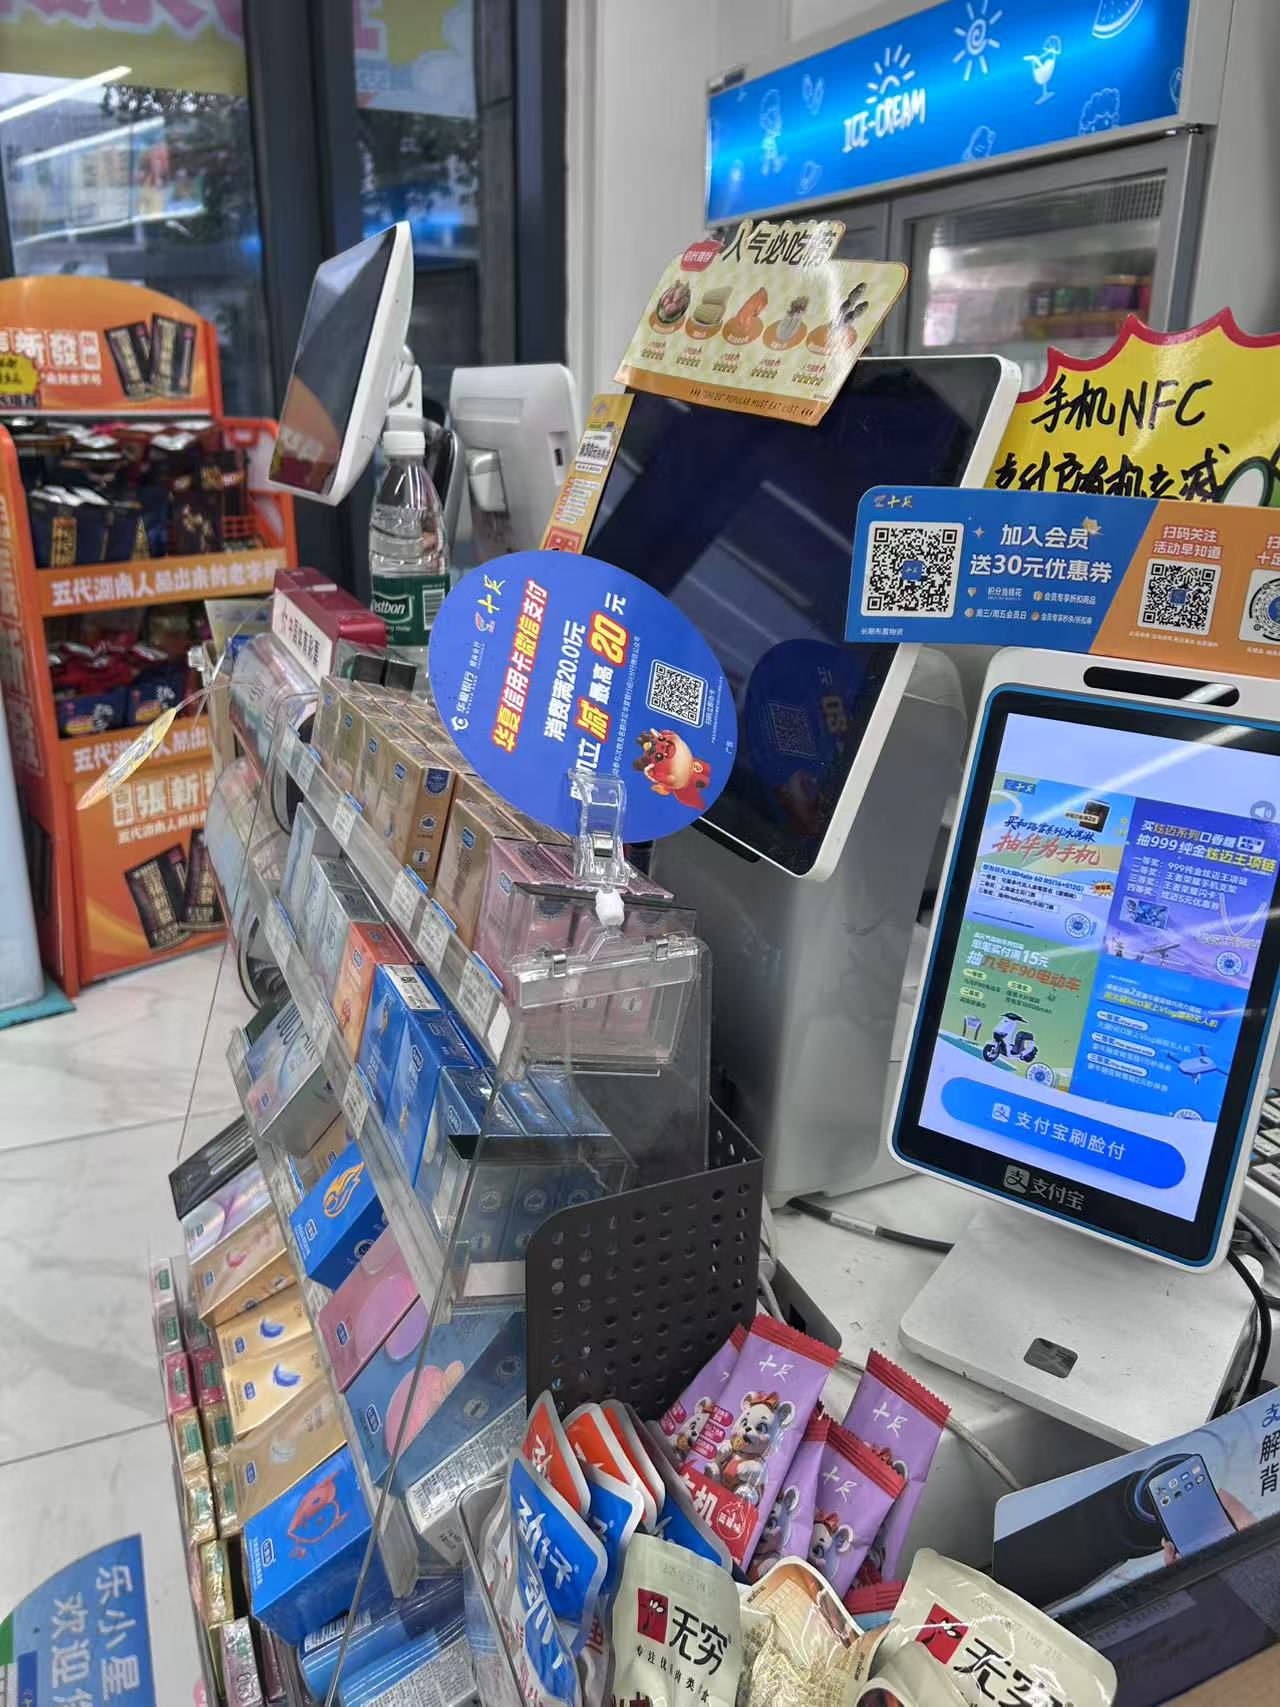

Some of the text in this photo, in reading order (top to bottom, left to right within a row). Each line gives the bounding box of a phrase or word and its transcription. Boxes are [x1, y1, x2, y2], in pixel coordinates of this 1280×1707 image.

[842, 87, 926, 153] ICE-CREAM
[1000, 523, 1089, 551] 加入会员
[1152, 540, 1223, 561] 活动早知道
[1162, 525, 1218, 544] 扫码关注
[969, 553, 1113, 583] 送30元优惠券
[492, 579, 548, 752] 华夏信用卡微信支付
[543, 619, 586, 743] 消费满20.01元
[992, 830, 1100, 866] 抽华为手机
[1014, 1111, 1127, 1161] 支付宝刷脸付
[1030, 1177, 1086, 1212] 支付宝
[1260, 1462, 1279, 1497] 背
[668, 1605, 729, 1676] 无穷
